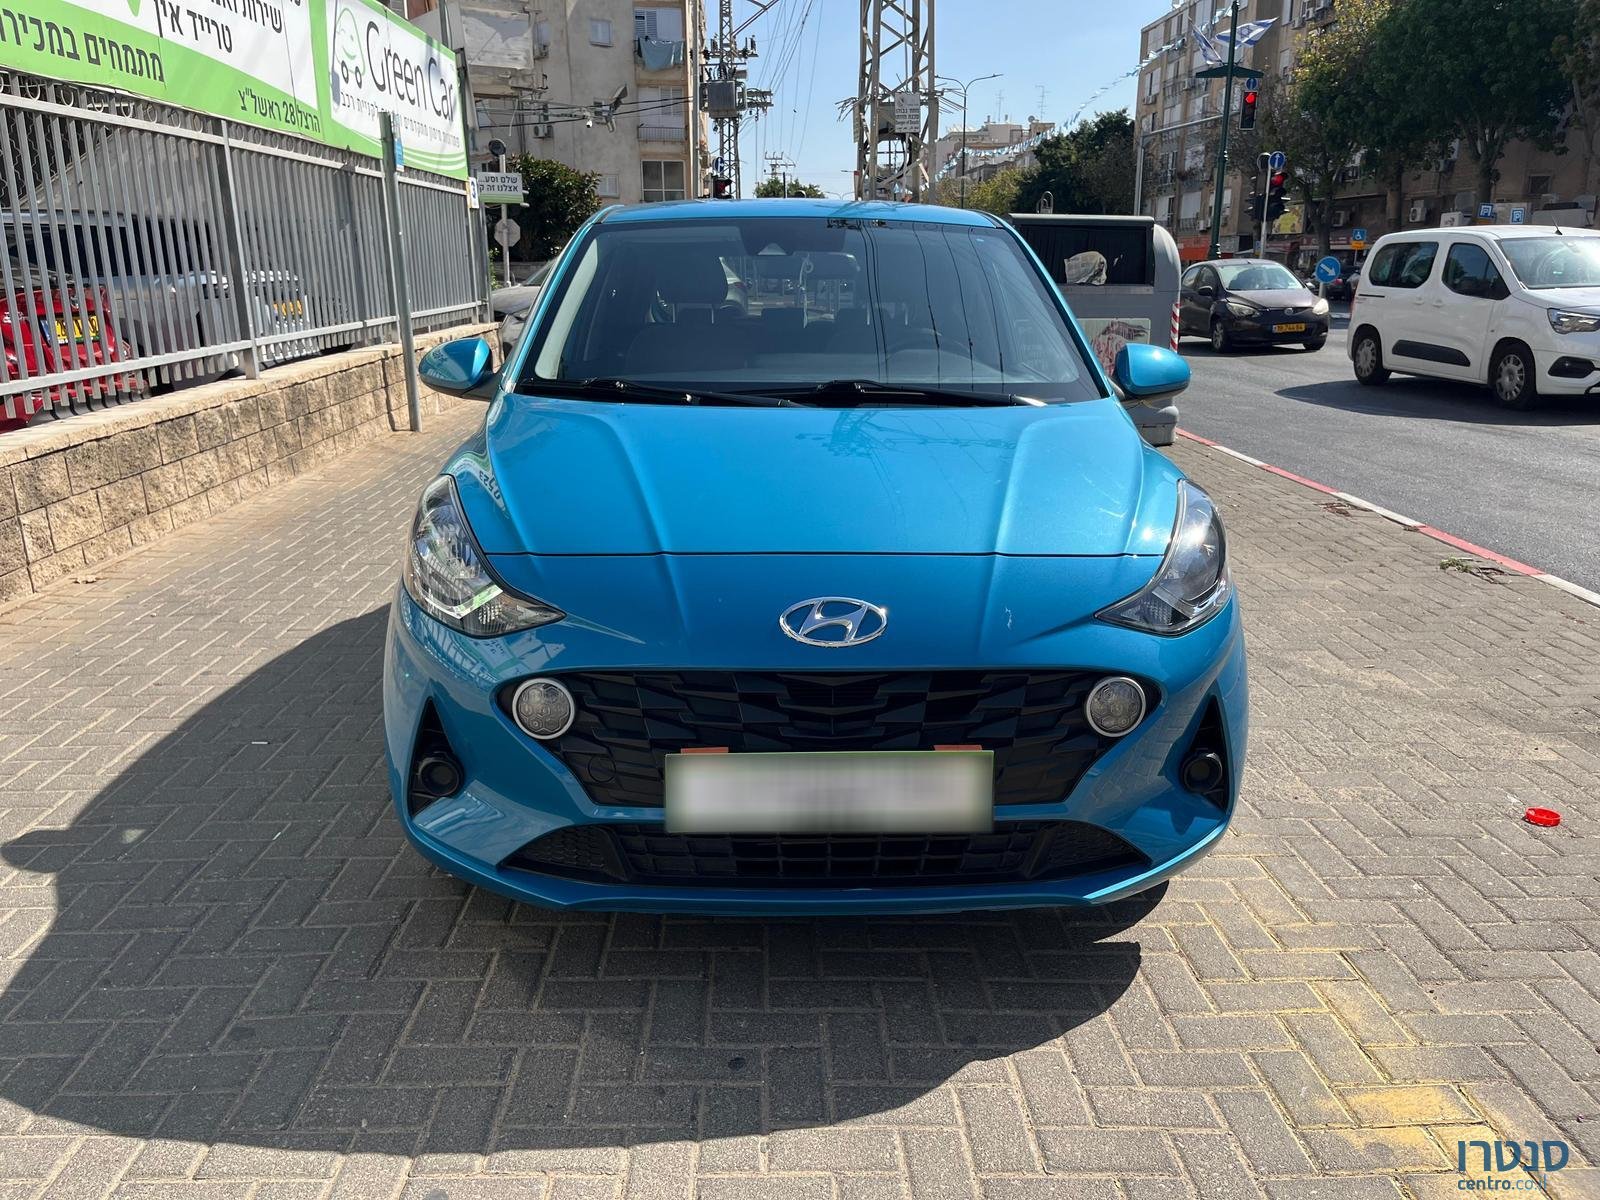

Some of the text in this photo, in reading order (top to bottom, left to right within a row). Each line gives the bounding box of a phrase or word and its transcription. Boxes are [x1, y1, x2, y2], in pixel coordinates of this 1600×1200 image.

[187, 9, 232, 53] טרייד
[84, 32, 164, 82] מתמחים
[366, 21, 453, 122] Green Car
[282, 101, 296, 126] 28
[497, 184, 519, 192] אצלנו
[500, 175, 518, 184] שלם
